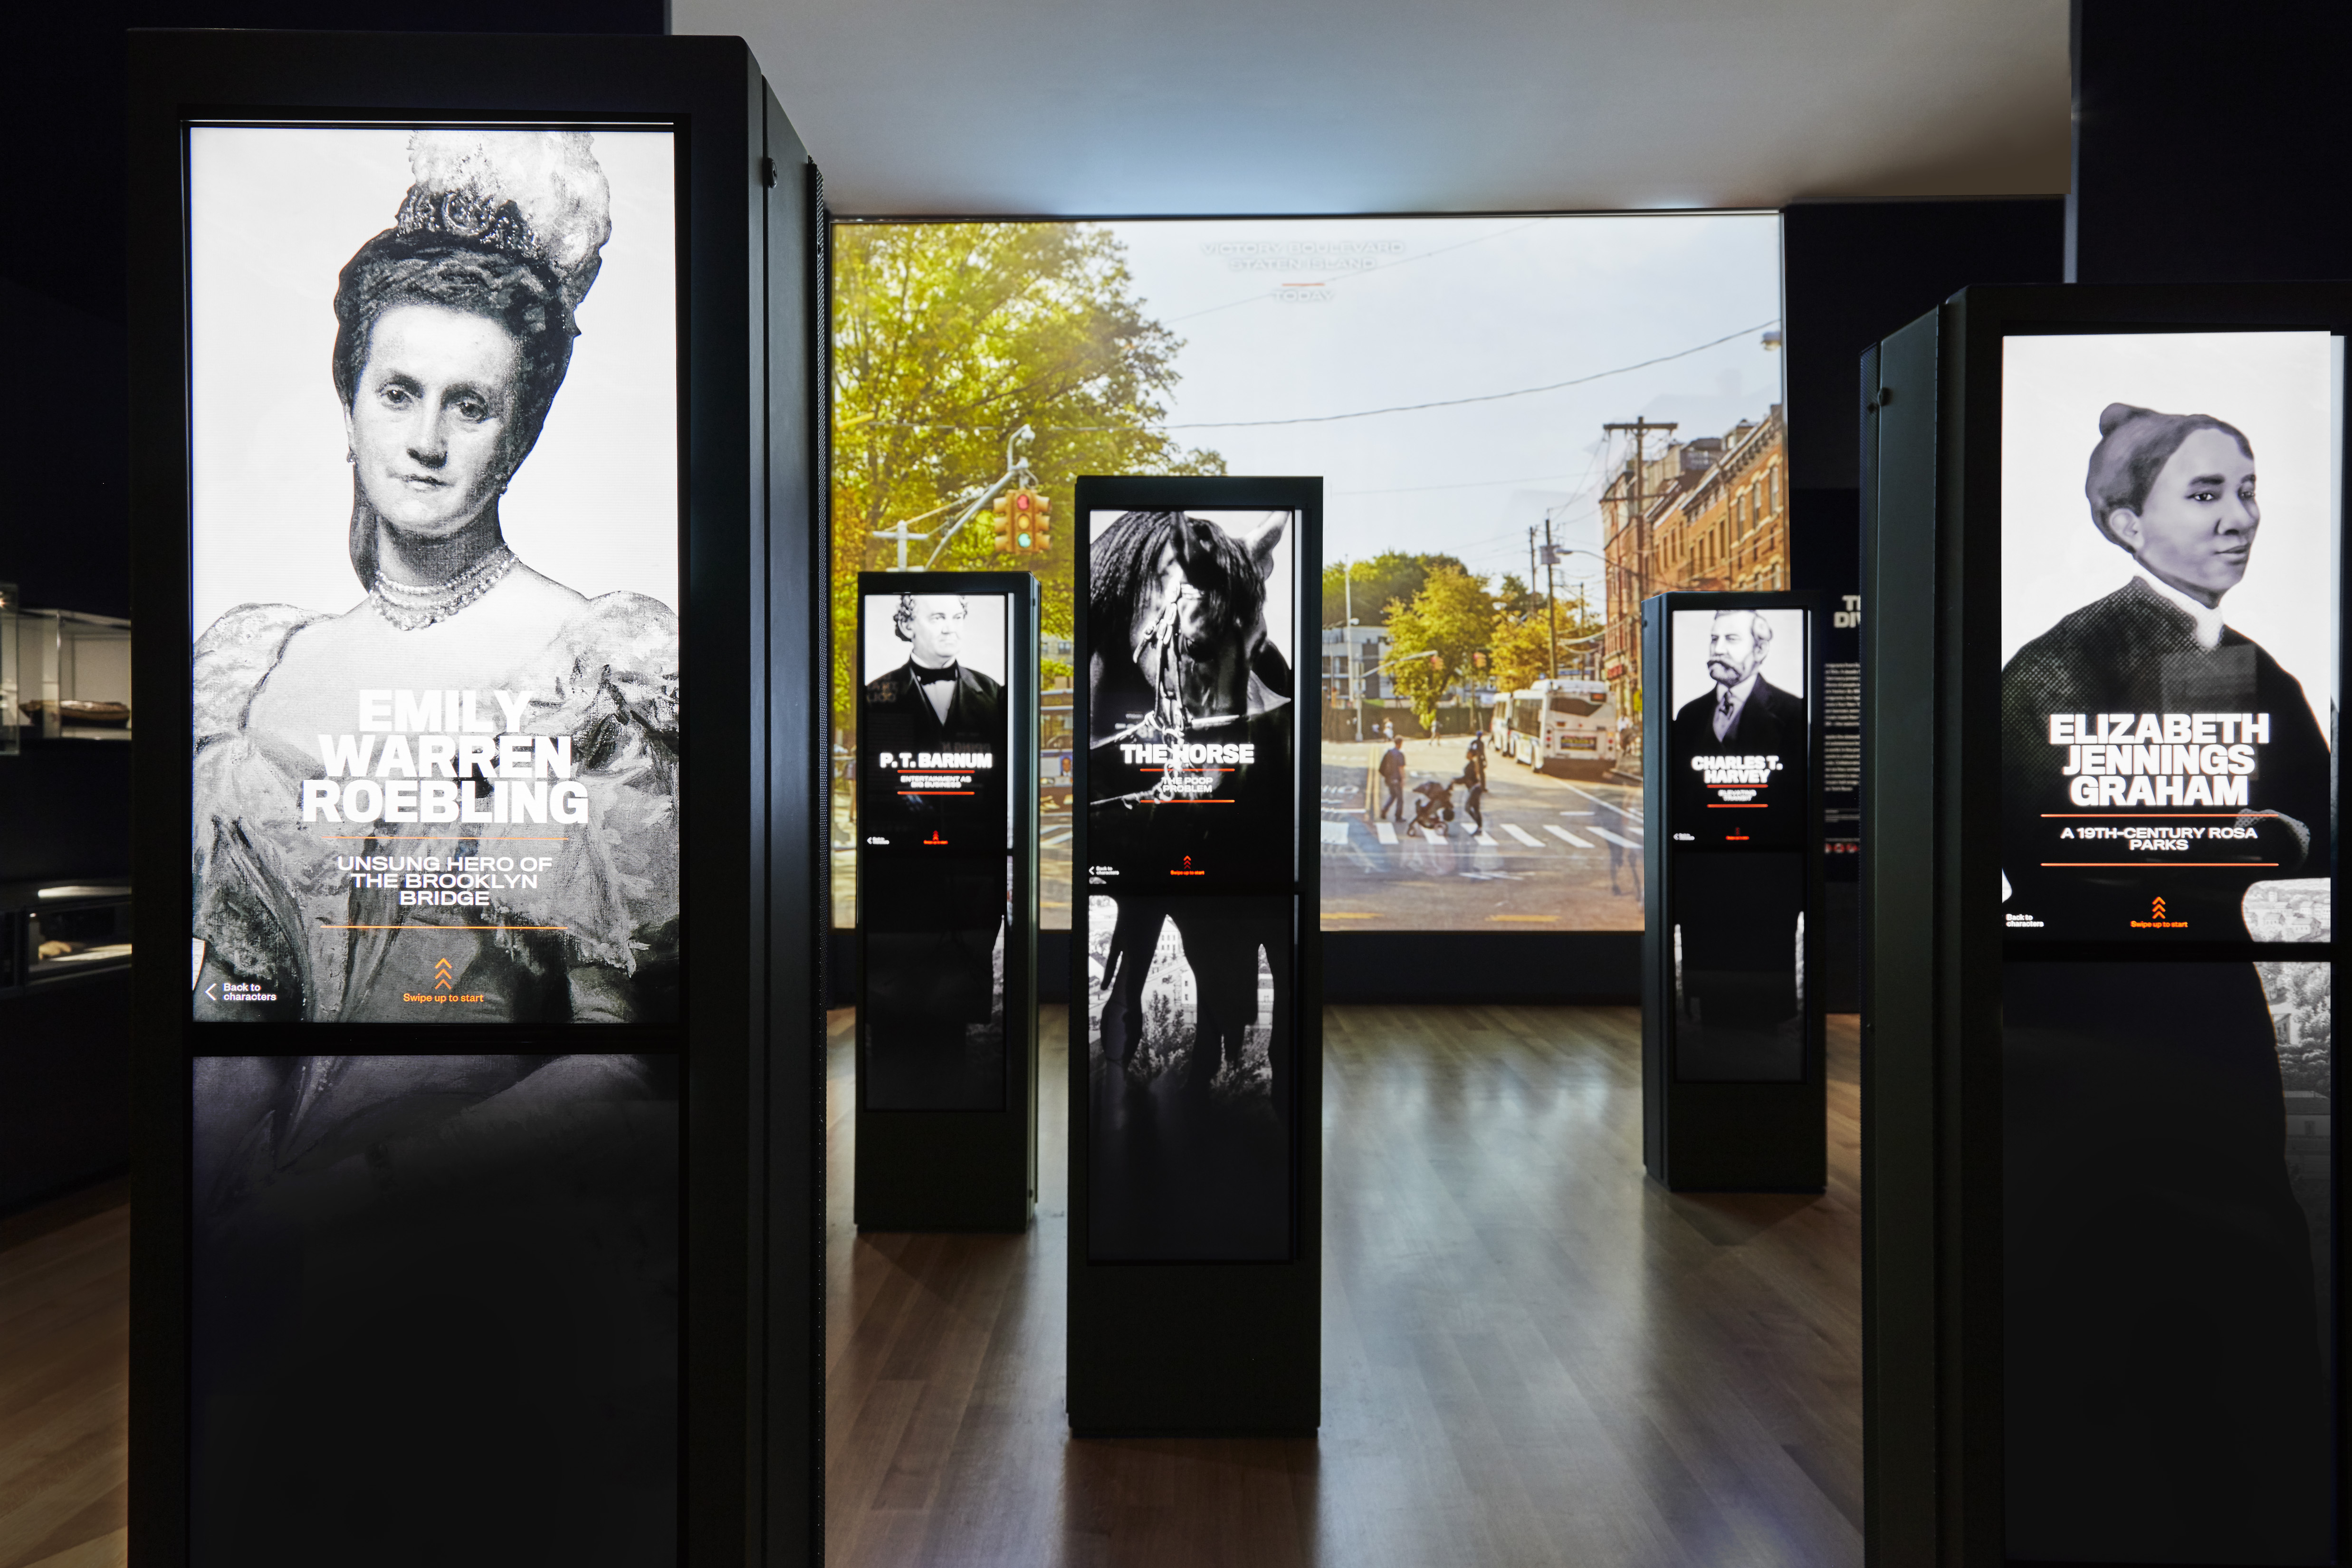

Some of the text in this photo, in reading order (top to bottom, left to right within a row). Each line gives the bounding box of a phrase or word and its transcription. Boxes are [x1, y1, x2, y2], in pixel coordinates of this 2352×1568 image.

[1202, 241, 1405, 255] VICTORY BOULEVARD
[1230, 257, 1377, 271] STATEN ISLAND
[1273, 290, 1334, 302] TODAY
[359, 689, 533, 733] EMILY
[2049, 713, 2270, 744] ELIZABETH
[318, 734, 572, 778] WARREN
[880, 752, 993, 769] P. T. BARNUM
[1120, 744, 1254, 764] THE HORSE
[2062, 744, 2256, 775] JENNINGS
[1691, 755, 1784, 770] CHARLES T.
[1162, 777, 1213, 785] THE POOP
[1704, 769, 1771, 784] HARVEY
[1163, 784, 1213, 793] PROBLEM
[2070, 775, 2248, 807] GRAHAM
[302, 779, 588, 824] ROEBLING
[2060, 827, 2258, 839] A 19TH-CENTURY ROSA
[2128, 839, 2189, 851] PARKS
[338, 856, 553, 872] UNSUNG HERO OF
[350, 873, 538, 889] THE BROOKLYN
[399, 890, 489, 906] BRIDGE
[2130, 920, 2152, 928] Swipe
[223, 983, 261, 992] Back to
[223, 992, 277, 1001] characters
[403, 993, 484, 1004] Swipe up to start
